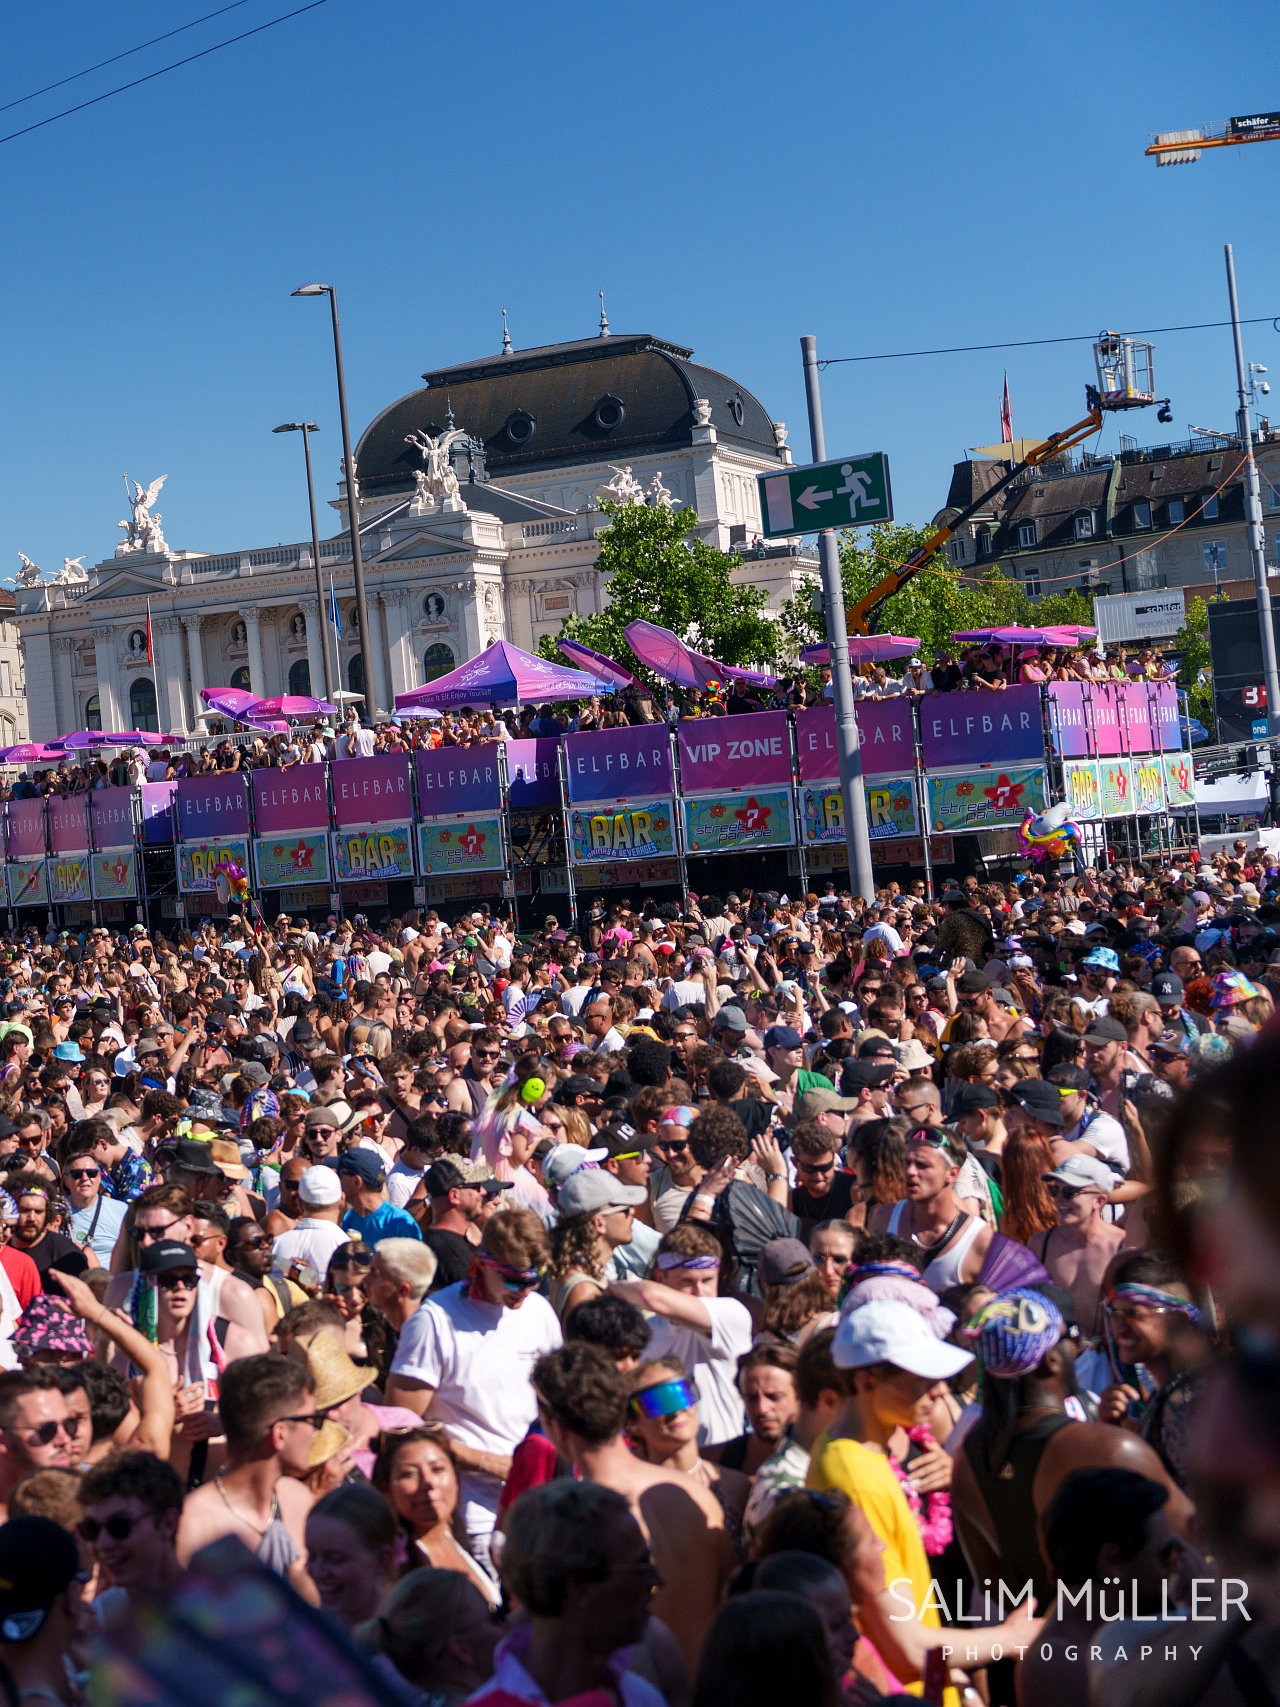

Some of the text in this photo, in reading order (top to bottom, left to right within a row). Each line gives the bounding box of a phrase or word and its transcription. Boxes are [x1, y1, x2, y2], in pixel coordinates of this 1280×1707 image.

[1238, 117, 1269, 127] schäfer
[1146, 603, 1181, 613] schäfer
[932, 711, 1030, 738] ELFBAR
[1253, 725, 1267, 734] one
[809, 724, 902, 750] ELBAR
[687, 737, 783, 763] VIP ZONE
[578, 749, 662, 774] ELFBAR
[341, 776, 405, 799] ELFBAR
[427, 767, 492, 789] ELFBAR
[1071, 770, 1093, 805] BAR
[1138, 767, 1159, 801] BAR
[186, 794, 243, 815] ELFBAR
[261, 786, 321, 807] ELFBAR
[97, 807, 132, 825] ELFBAR
[824, 790, 893, 829] BR
[940, 799, 996, 815] street
[965, 806, 1025, 824] parade
[589, 812, 652, 850] BAR
[695, 820, 748, 836] street
[718, 826, 772, 844] parade
[820, 828, 846, 840] DRINKS
[348, 835, 395, 869] BAR
[429, 846, 468, 858] street
[447, 853, 487, 867] parade
[586, 848, 611, 860] DRINKS
[619, 842, 658, 858] BEVERAGES
[264, 860, 298, 873] street
[278, 866, 315, 878] parade
[56, 861, 80, 892] BAR
